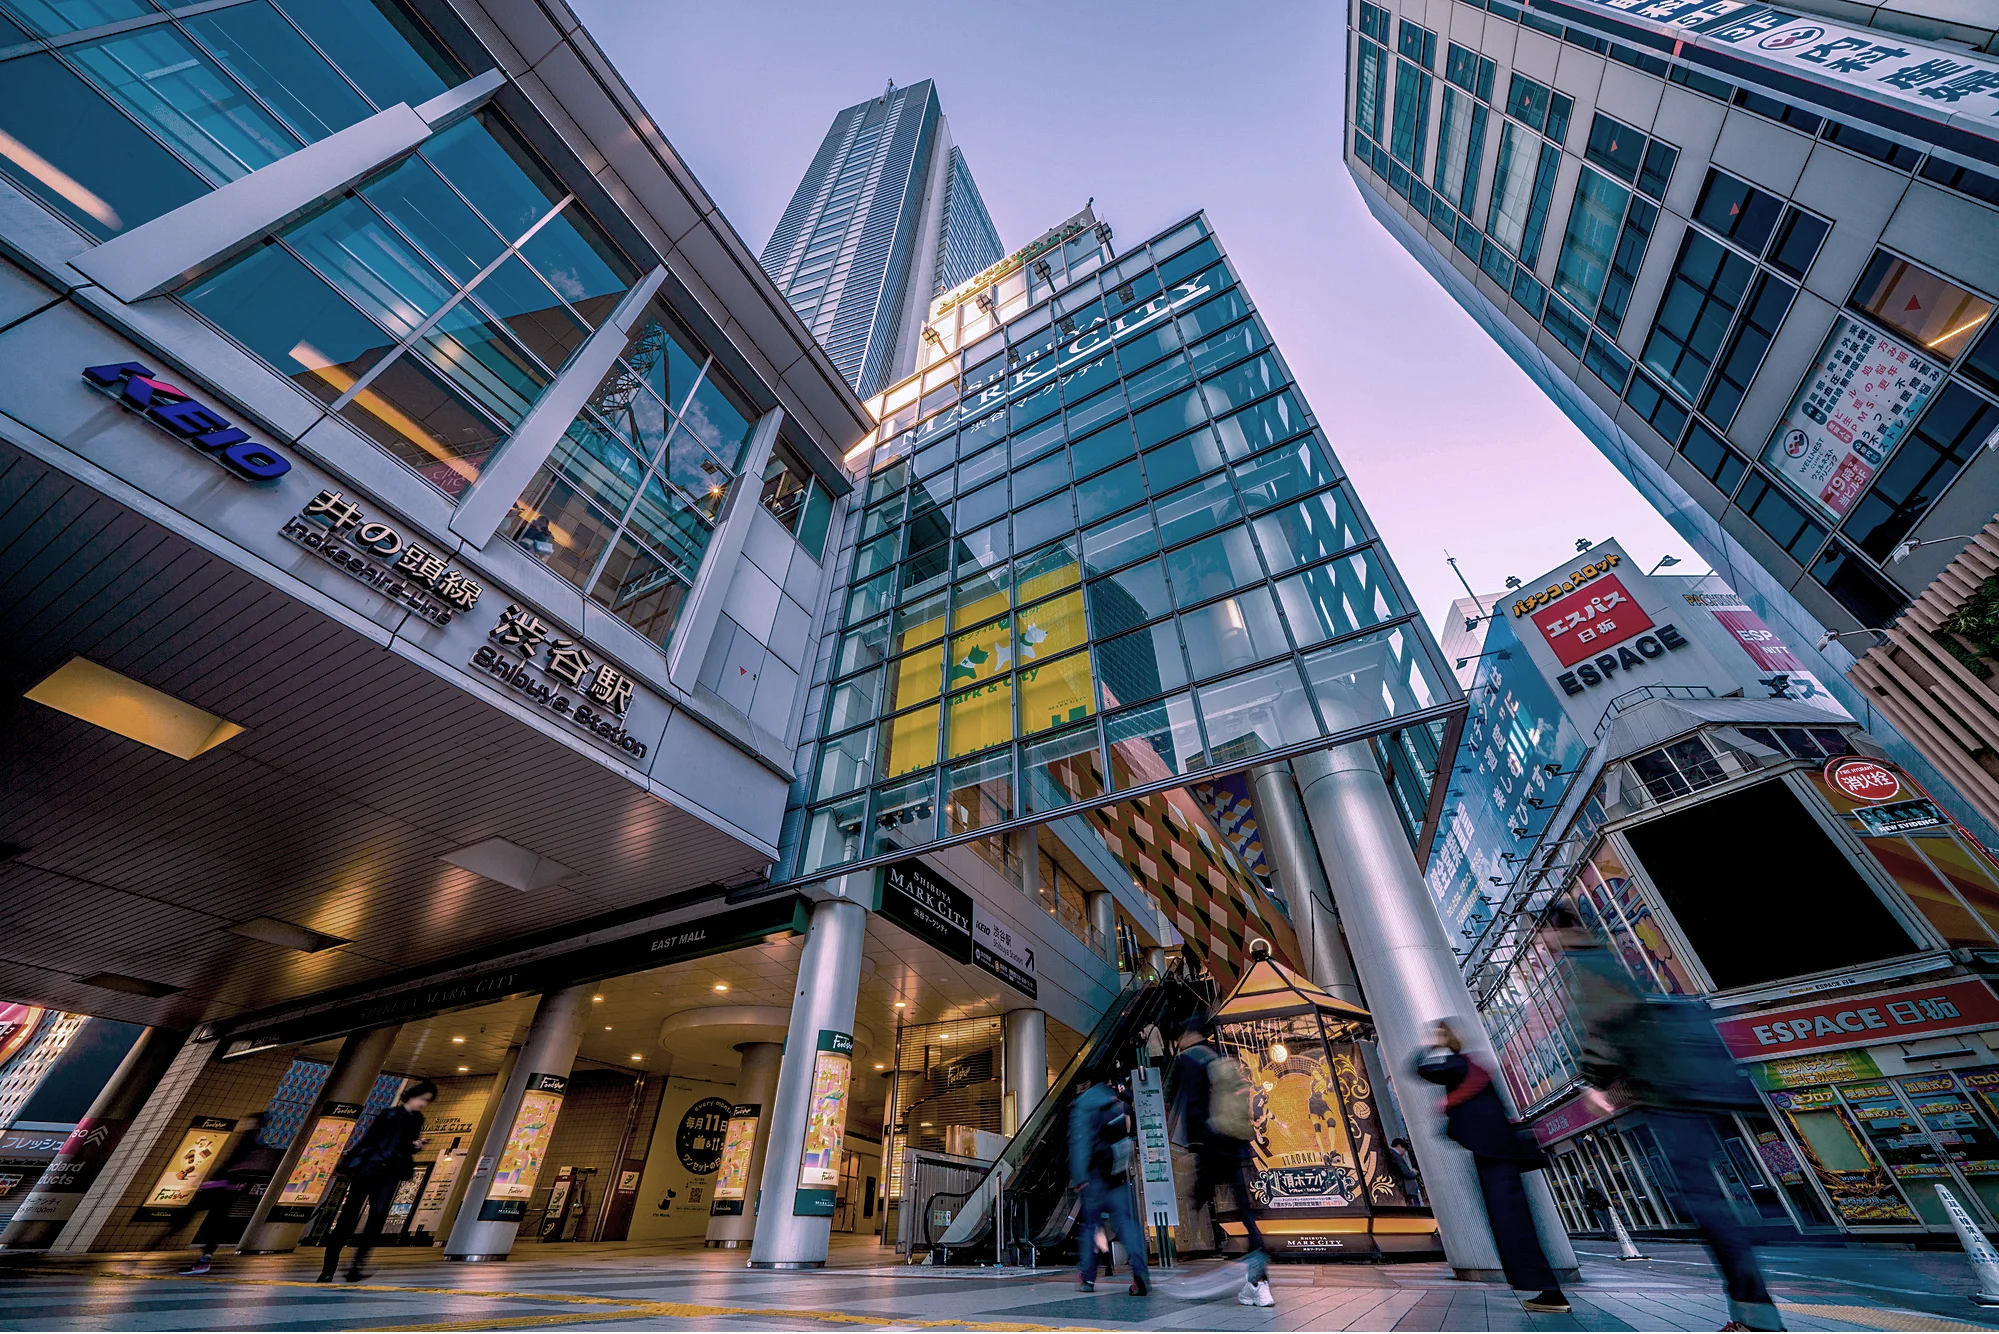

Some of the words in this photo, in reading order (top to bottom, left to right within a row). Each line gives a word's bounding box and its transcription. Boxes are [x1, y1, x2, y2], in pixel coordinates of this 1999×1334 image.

[1677, 3, 1728, 27] 5F
[1721, 15, 1778, 40] 3F
[1795, 37, 1911, 73] 内科
[901, 363, 1041, 446] MARK
[1069, 272, 1206, 355] CITY
[970, 357, 1105, 433] 渋谷マークシティ
[82, 361, 292, 482] KEIO
[1799, 437, 1824, 473] WELLNEST
[1811, 448, 1834, 480] ウェルネスト
[1819, 455, 1838, 482] クリニック
[302, 489, 484, 613] 井の頭線
[1512, 553, 1621, 618] パチンコ&スロット
[1546, 591, 1627, 639] エスパス
[1577, 618, 1618, 644] 日拓
[1736, 630, 1780, 642] ESP
[489, 604, 636, 714] 渋谷駅
[1556, 623, 1688, 696] ESPACE
[987, 683, 998, 693] &
[474, 645, 570, 714] Shibuya
[573, 704, 648, 759] Station
[1841, 770, 1894, 791] 消火栓
[1878, 824, 1898, 832] NEW
[1900, 818, 1940, 830] EVIDENCE
[890, 867, 935, 908] MARK
[937, 900, 969, 931] CITY
[913, 871, 952, 905] SHIBUYA
[913, 907, 949, 935] 渋谷マークシティ
[975, 920, 991, 936] KEIO
[650, 936, 677, 952] EAST
[678, 929, 707, 946] MALL
[993, 924, 1012, 948] 渋谷駅
[1815, 981, 1841, 990] ESPACE
[1752, 1006, 1888, 1047] ESPACE
[1886, 996, 1961, 1026] 日拓
[694, 1100, 714, 1113] every
[448, 1123, 473, 1131] CITY
[2, 1137, 65, 1150] フレッシュ
[1281, 1152, 1317, 1167] ITADAKI
[1282, 1172, 1325, 1189] 頂ホテル
